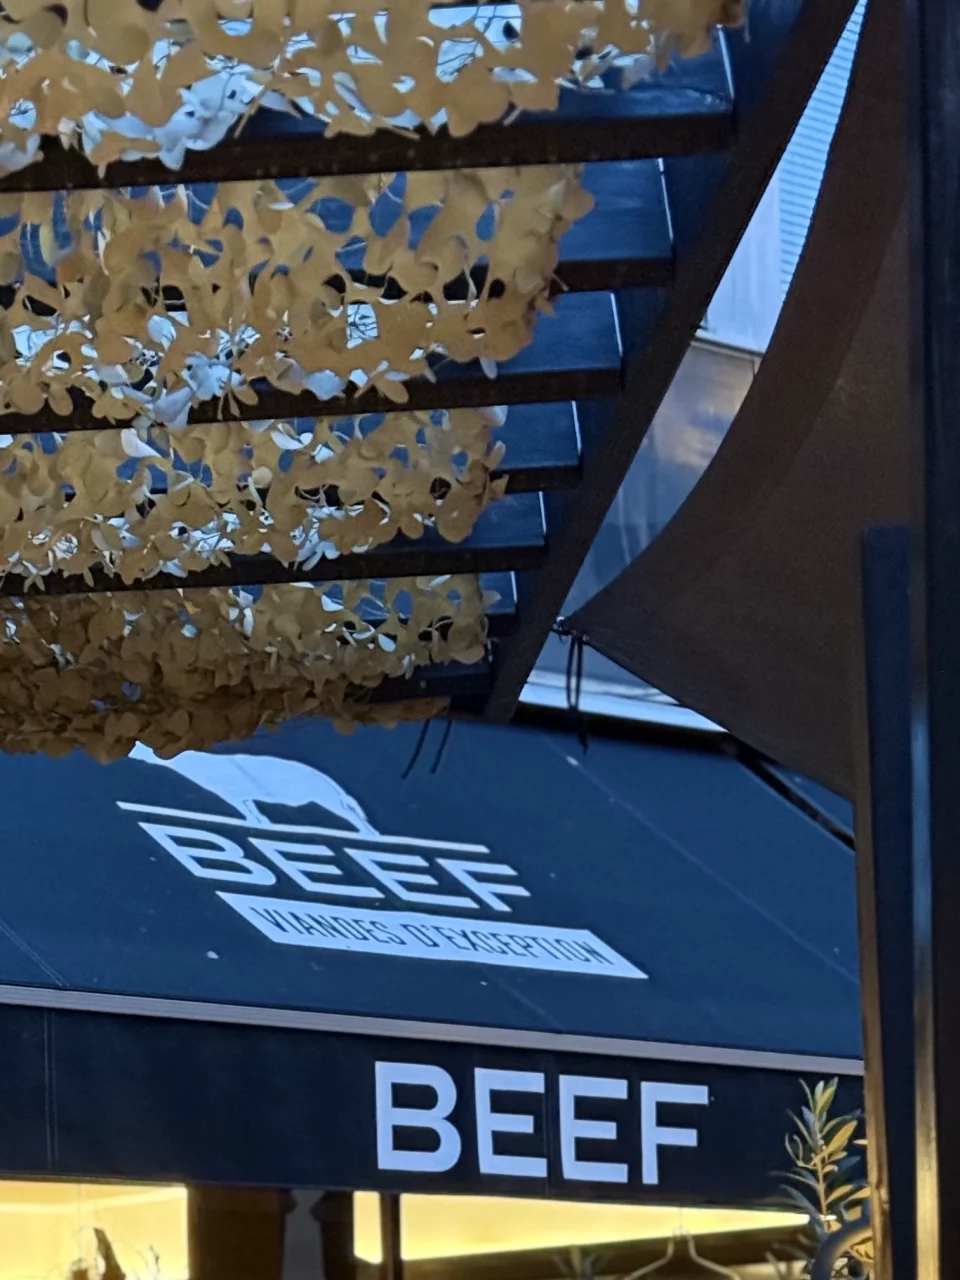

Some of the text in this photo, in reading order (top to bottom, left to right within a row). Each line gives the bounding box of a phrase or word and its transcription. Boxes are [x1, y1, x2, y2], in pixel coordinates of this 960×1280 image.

[138, 822, 531, 912] BEEF
[249, 906, 616, 967] VIANDES D'EXCEPTION
[375, 1061, 709, 1185] BEEF
